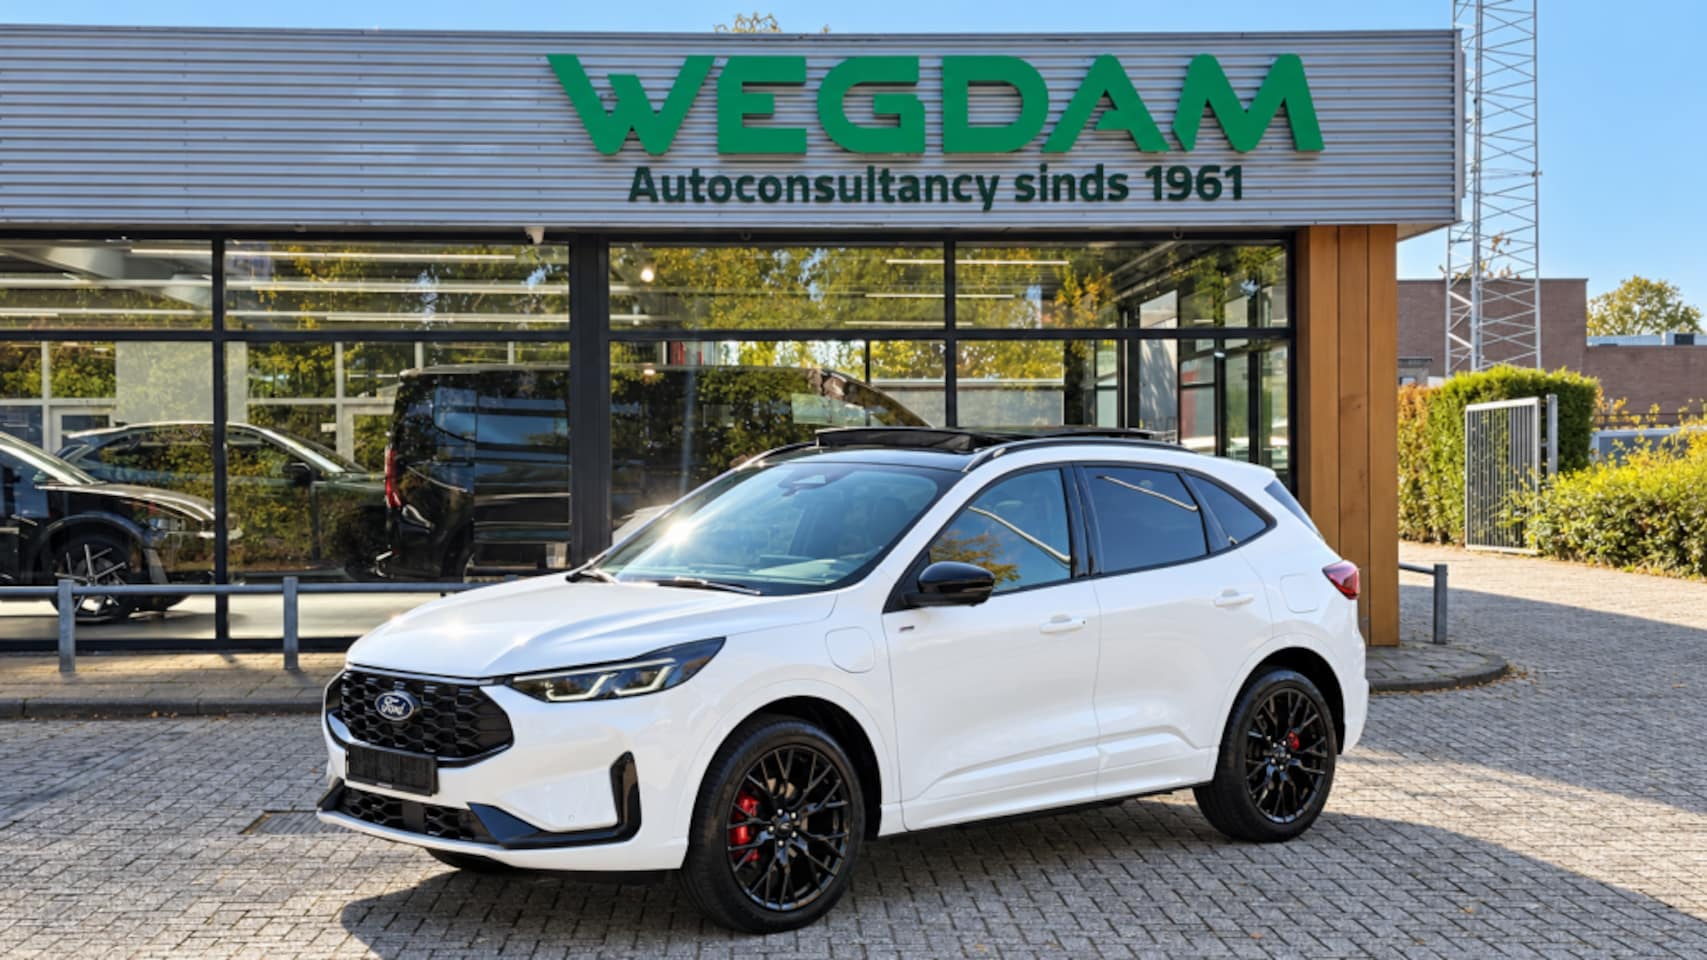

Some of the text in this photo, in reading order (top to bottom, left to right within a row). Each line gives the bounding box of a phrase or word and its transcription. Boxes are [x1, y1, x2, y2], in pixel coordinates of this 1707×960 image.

[547, 53, 1324, 155] WEGDAM
[629, 164, 1243, 212] Autoconsultancy sinds 1961
[379, 695, 408, 716] Ford
